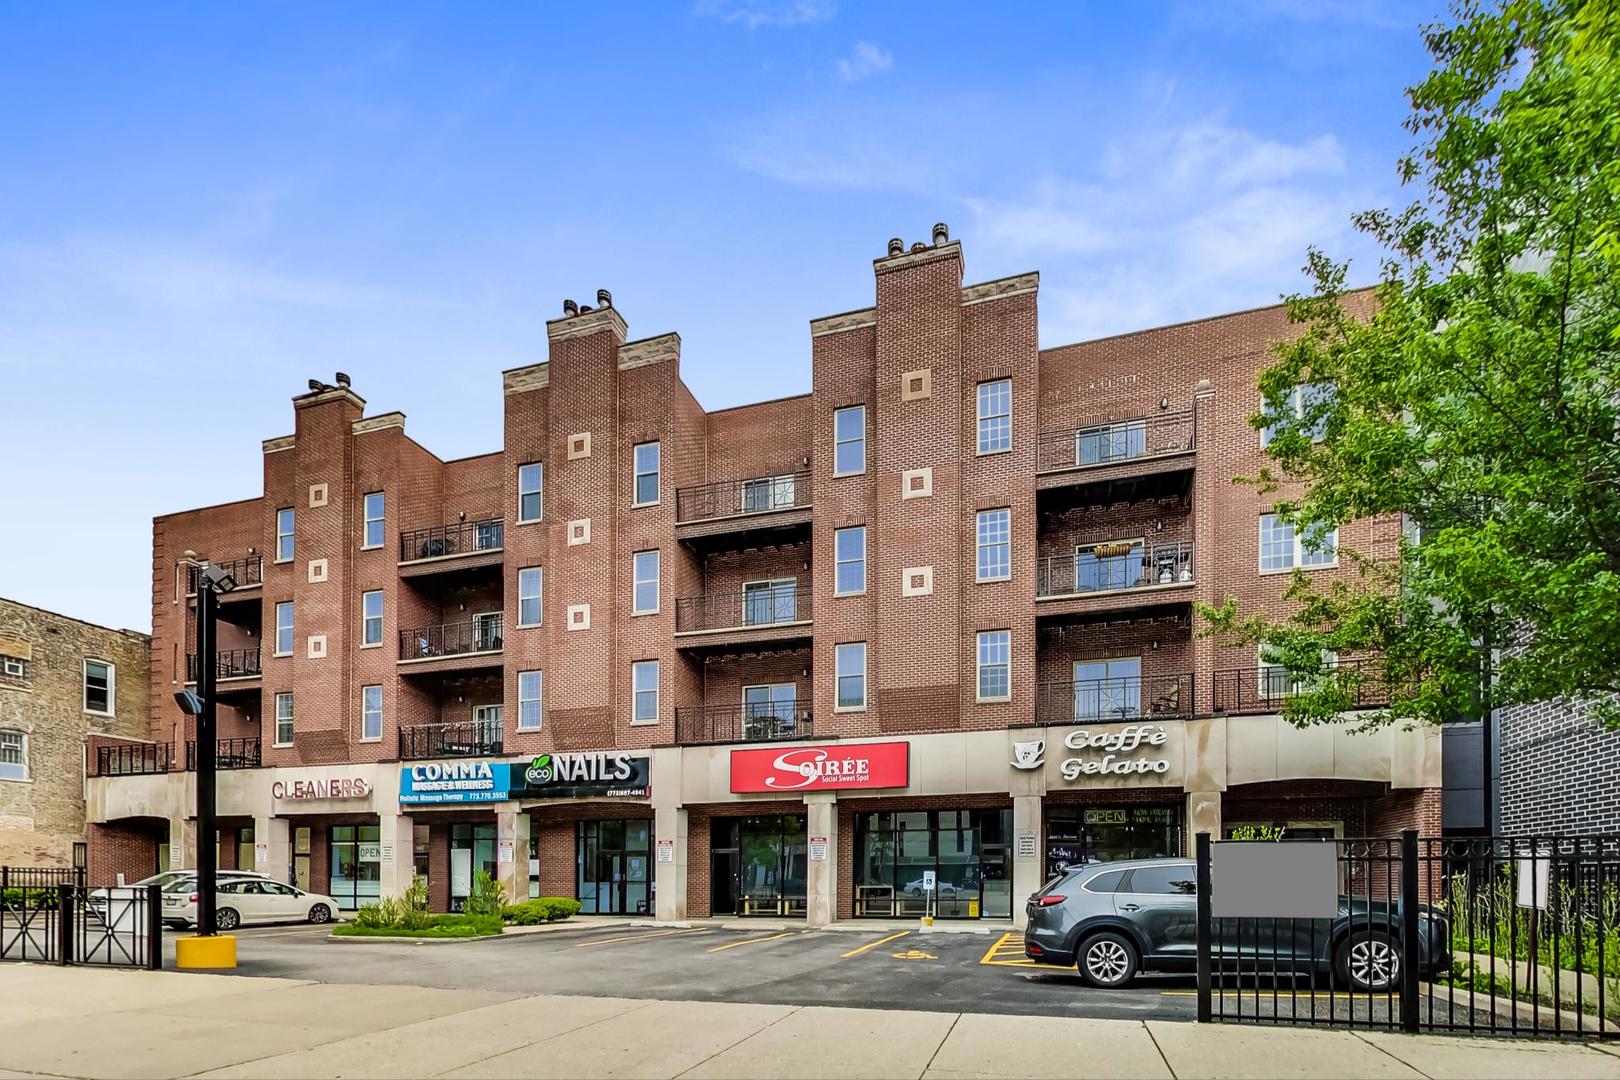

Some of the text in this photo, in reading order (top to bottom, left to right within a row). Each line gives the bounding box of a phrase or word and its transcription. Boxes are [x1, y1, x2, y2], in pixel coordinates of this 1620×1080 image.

[1064, 725, 1168, 752] Caffè
[411, 761, 493, 781] COMMA
[528, 752, 632, 781] eco NAILS
[765, 748, 869, 789] SOIRÉE
[1060, 754, 1170, 781] Gelato
[272, 778, 366, 799] CLEANERS
[822, 774, 869, 784] Social Sweet Spot
[419, 794, 443, 802] Massage
[1086, 810, 1125, 824] OPEN
[360, 847, 380, 858] OPEN
